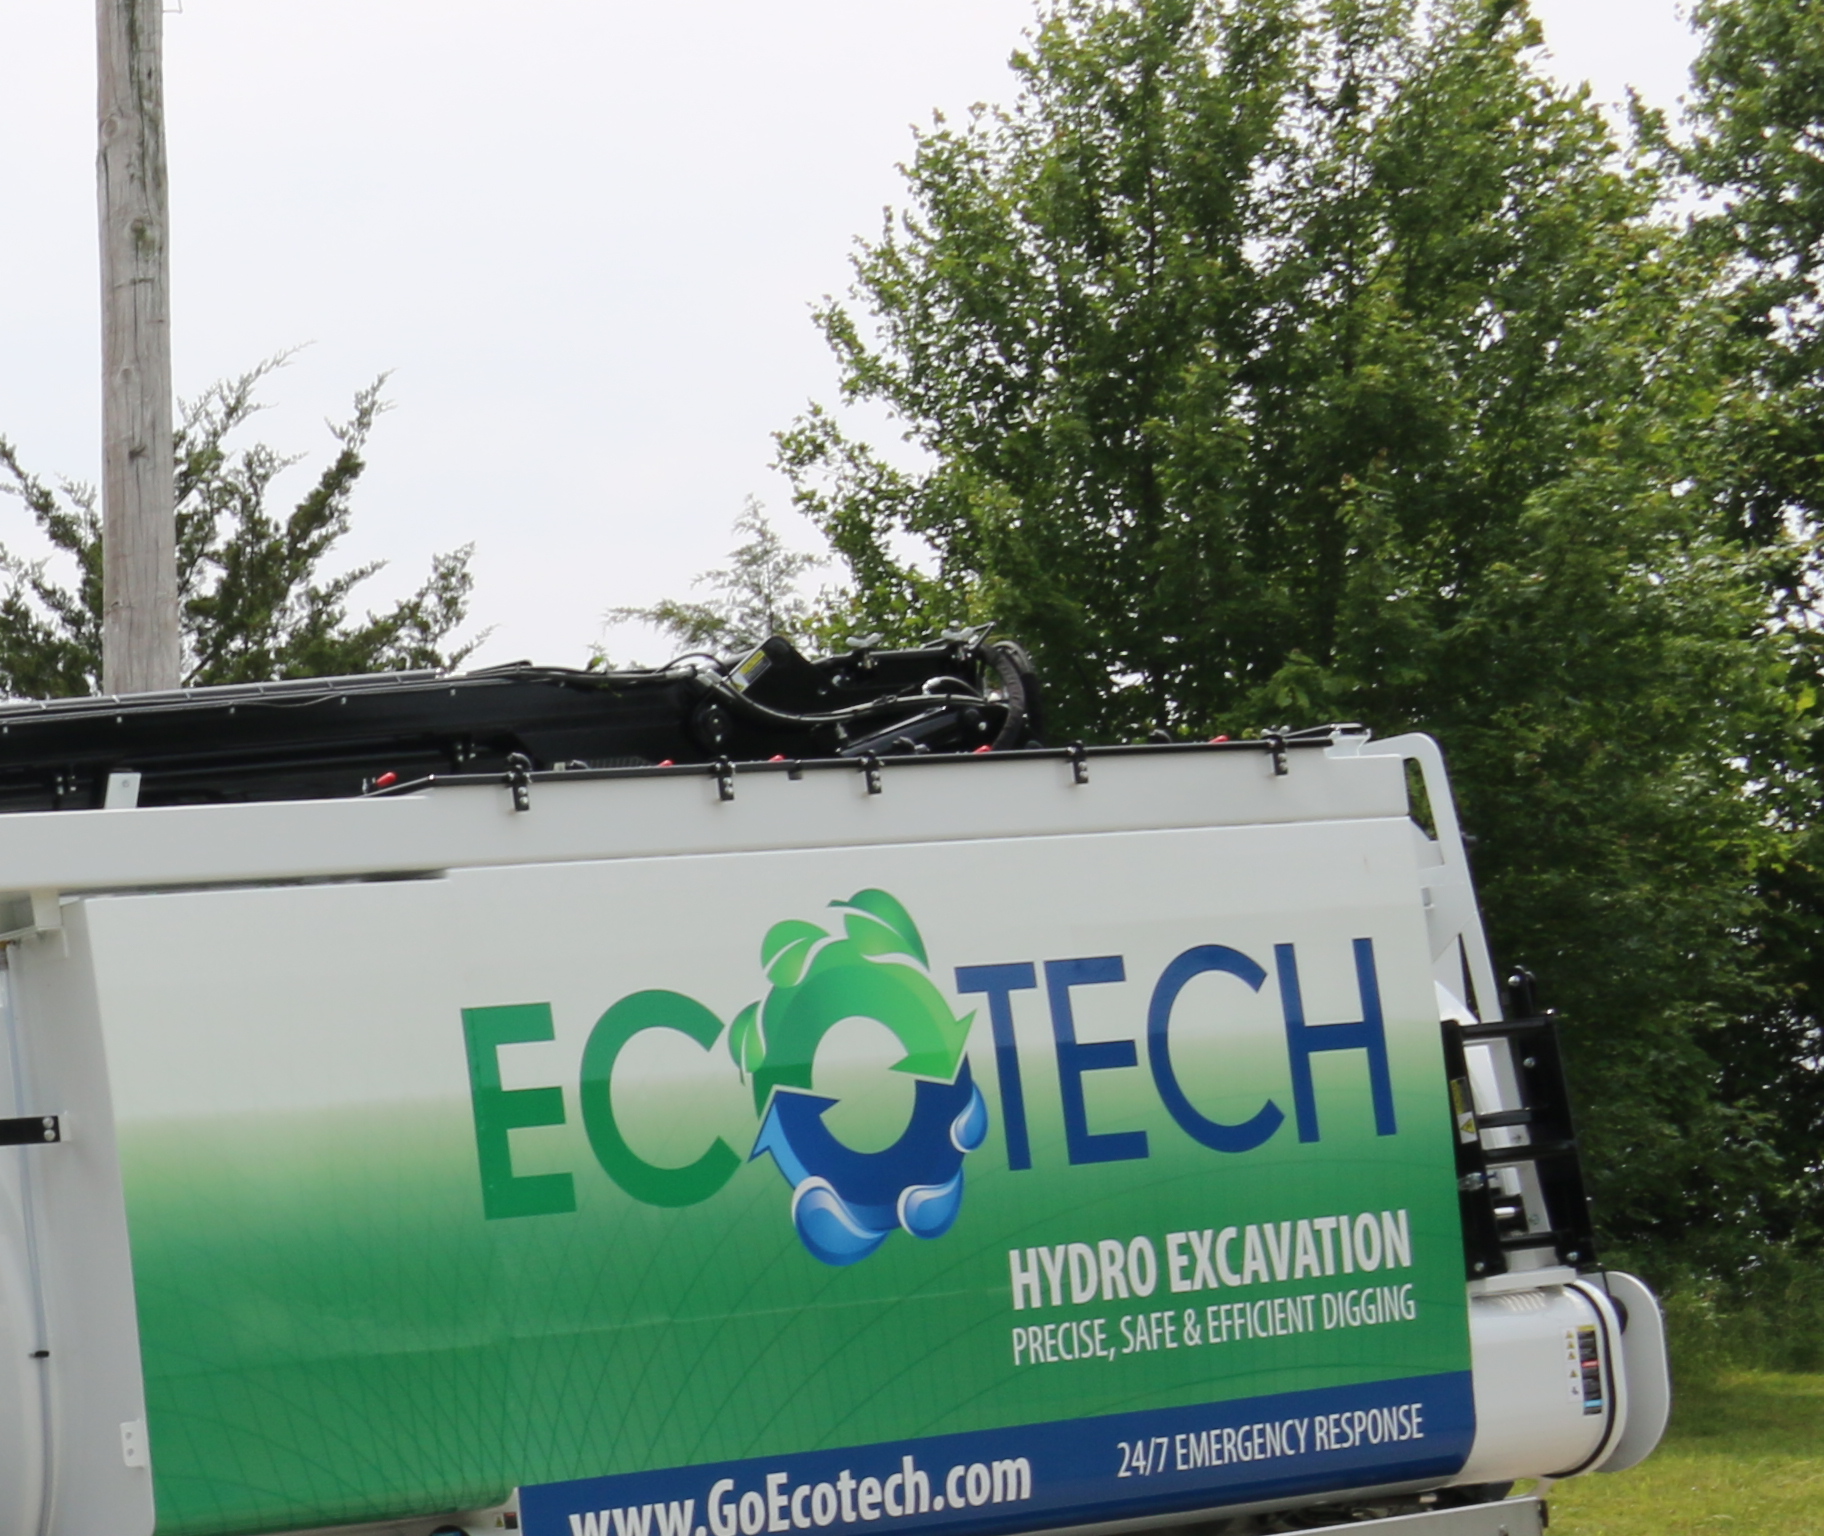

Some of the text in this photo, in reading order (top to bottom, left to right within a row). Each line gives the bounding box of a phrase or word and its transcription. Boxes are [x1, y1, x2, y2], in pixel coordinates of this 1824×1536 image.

[1008, 1209, 1412, 1310] HYDRO EXCAVATION
[1012, 1284, 1417, 1366] PRECISE, SAFE & EFFICIENT DIGGING
[1117, 1403, 1425, 1480] 24/7 EMERGENCY RESPONSE
